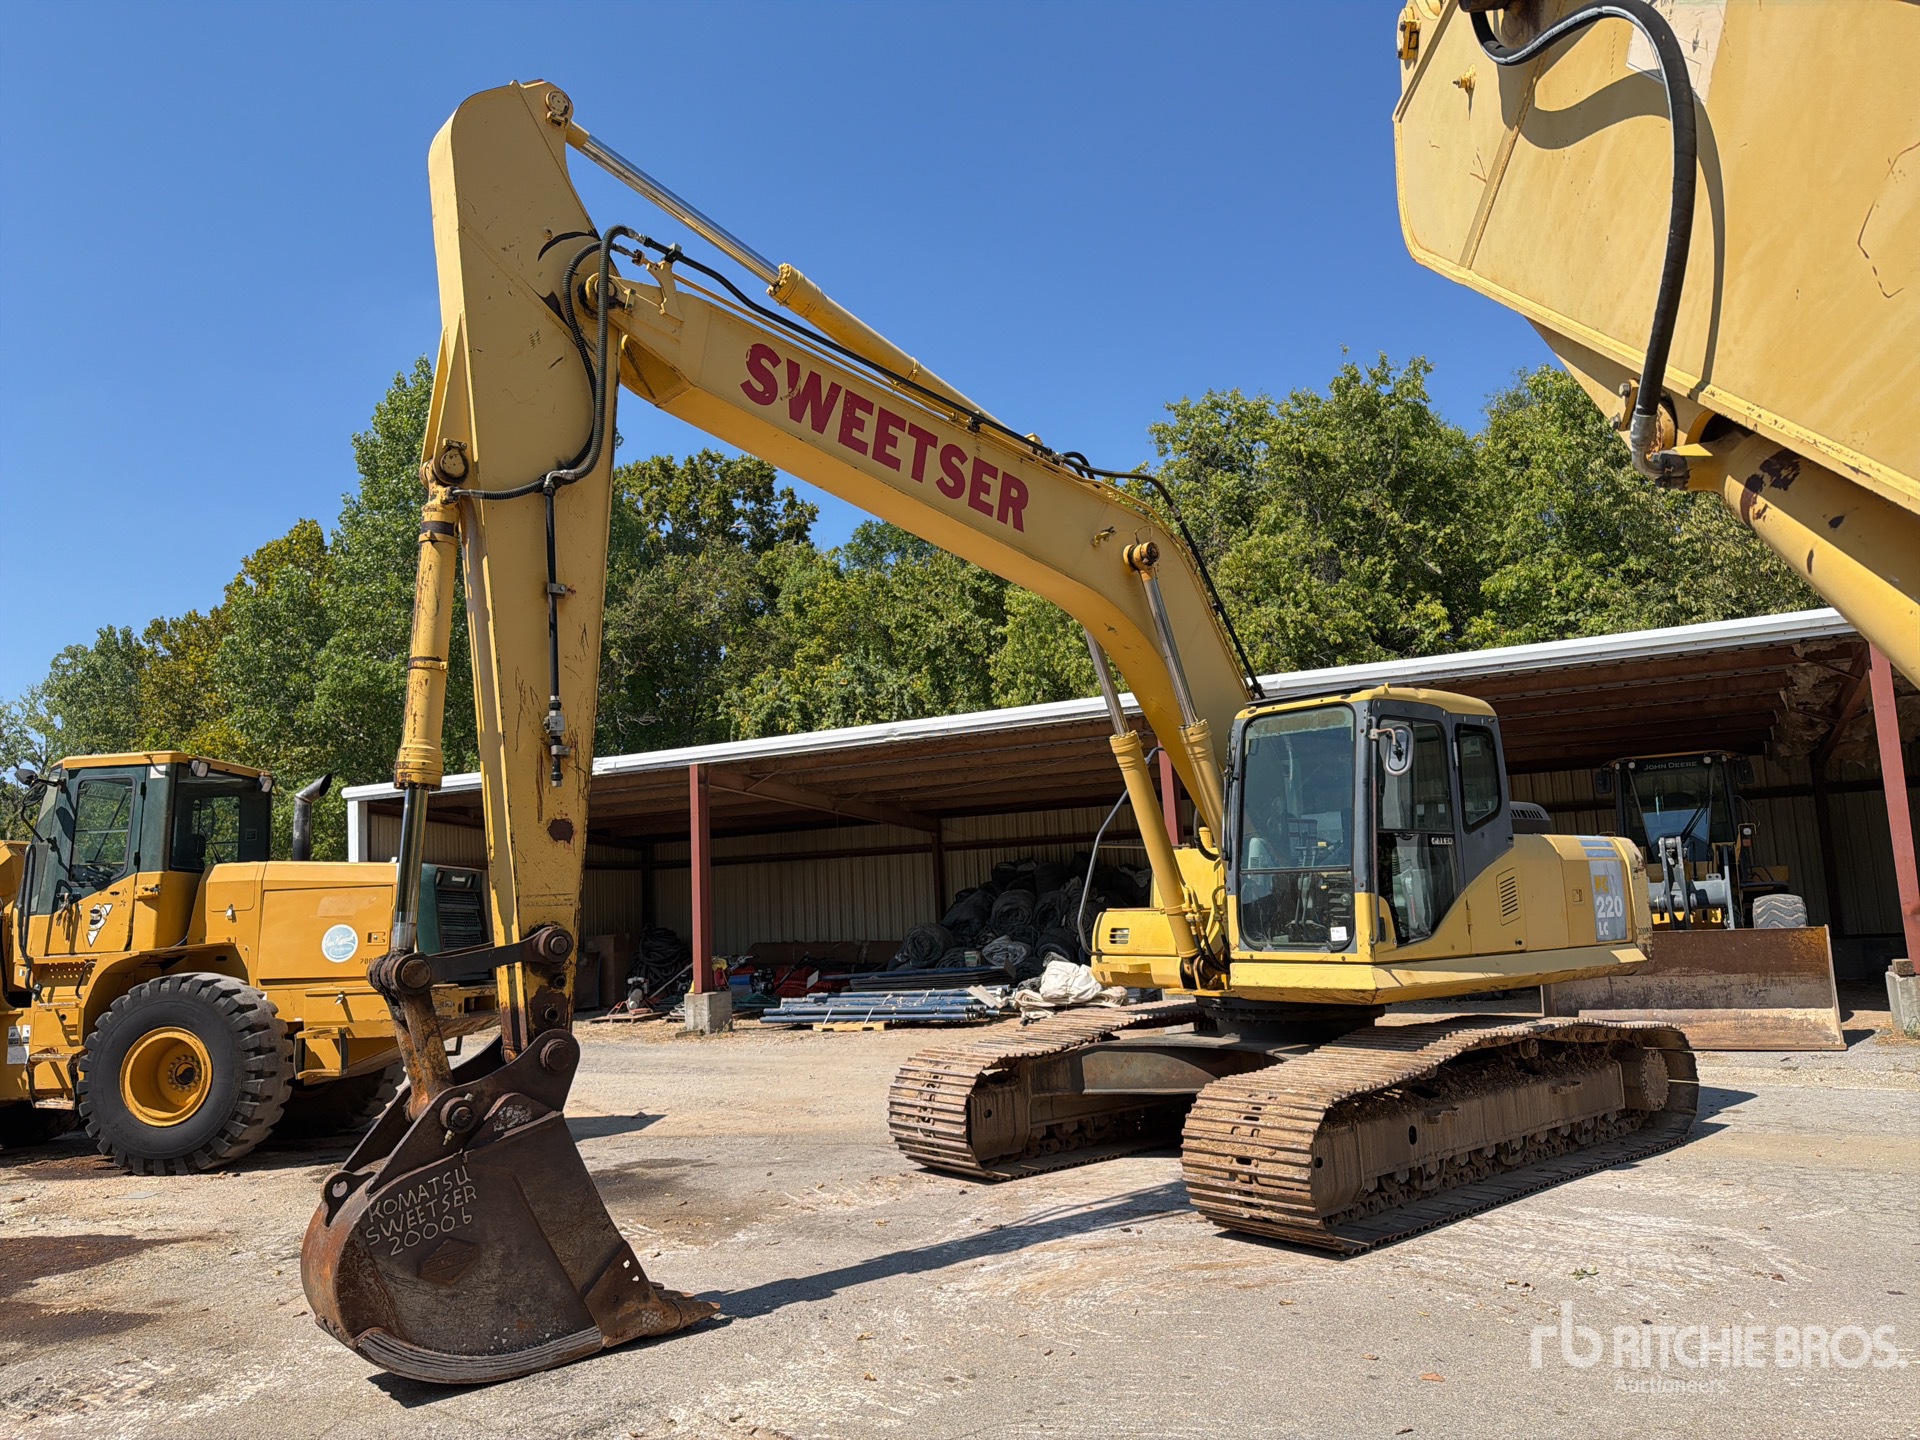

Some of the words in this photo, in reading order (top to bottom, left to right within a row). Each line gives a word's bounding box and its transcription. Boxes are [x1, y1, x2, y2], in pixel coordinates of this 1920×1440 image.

[740, 343, 1029, 533] SWEETSER
[1643, 763, 1667, 771] JOHN
[1668, 761, 1698, 769] DEERE
[1596, 895, 1623, 919] 220
[1598, 921, 1609, 936] LC
[367, 1165, 472, 1223] KOMATSU
[365, 1185, 477, 1246] SWEETSER
